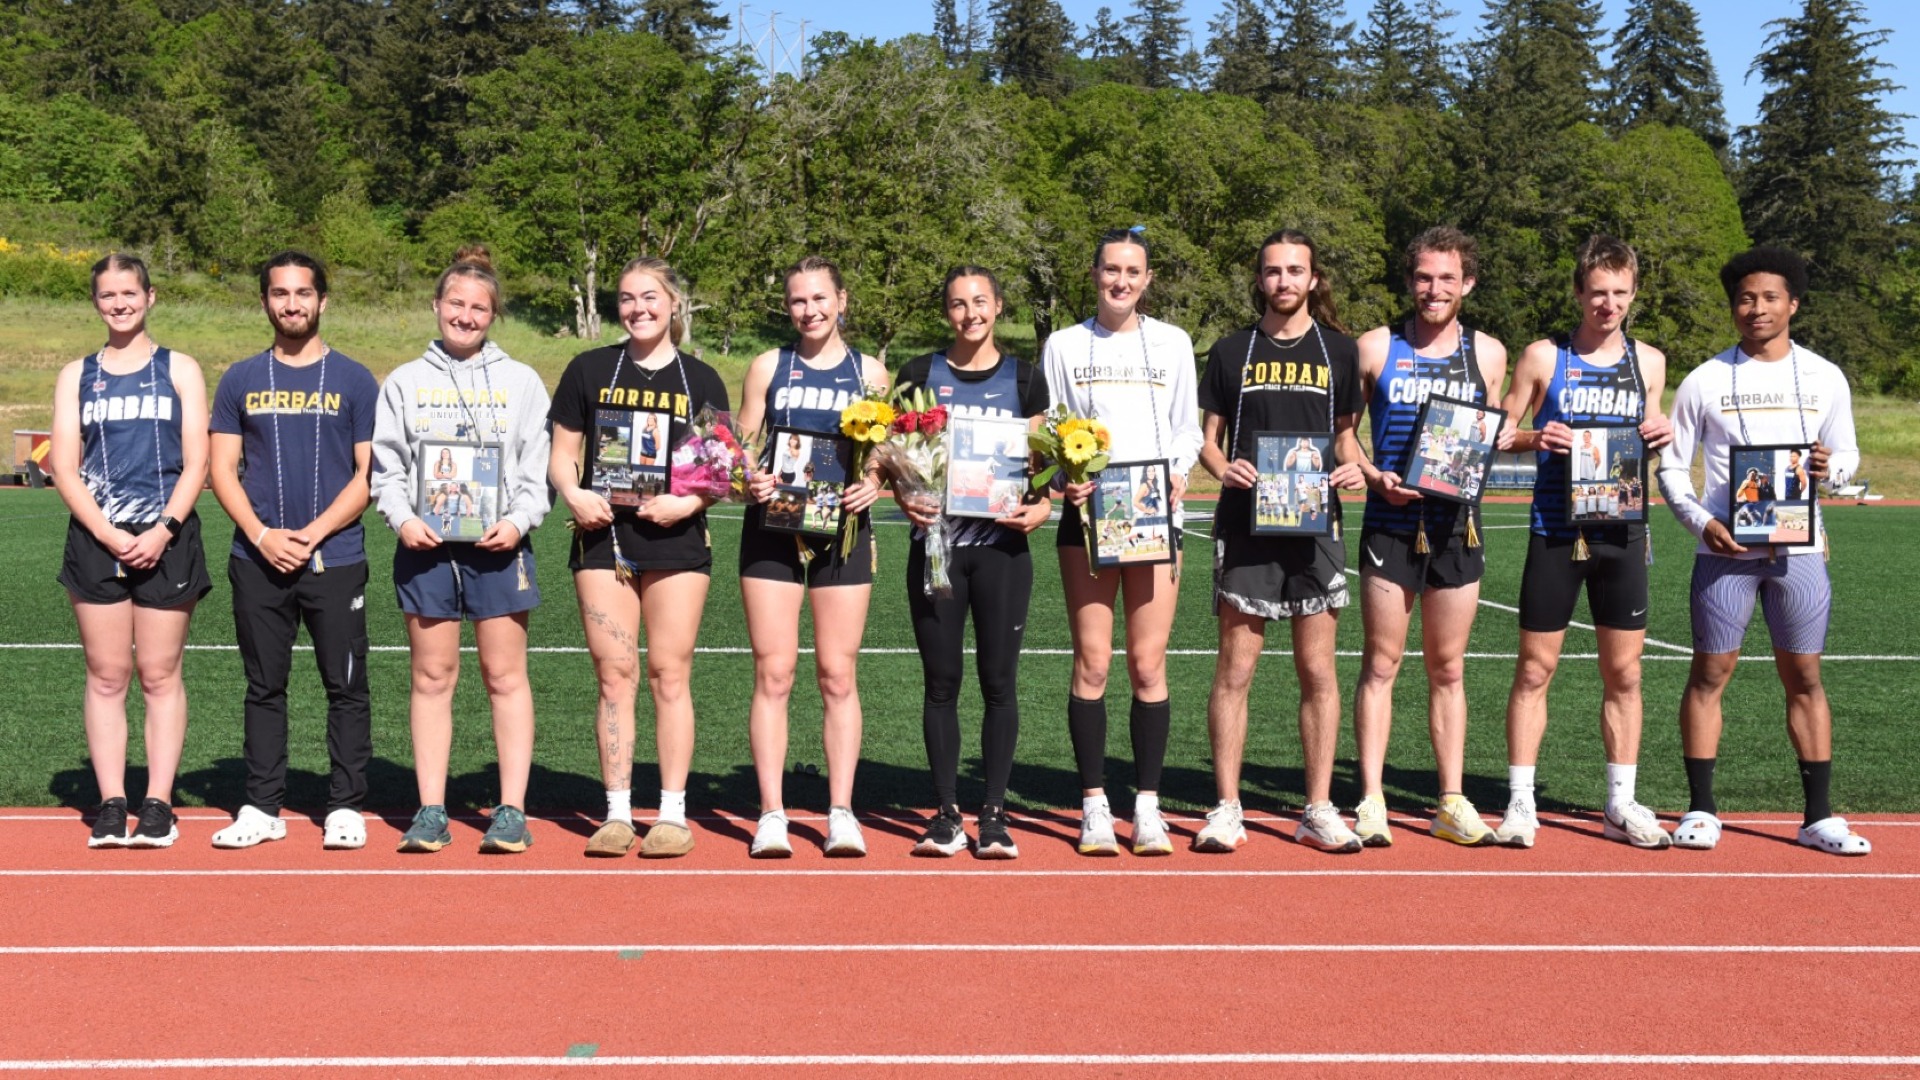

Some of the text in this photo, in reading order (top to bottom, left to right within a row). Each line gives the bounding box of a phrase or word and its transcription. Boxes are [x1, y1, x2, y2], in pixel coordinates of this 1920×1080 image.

[1074, 366, 1134, 379] CORBAN
[1242, 361, 1329, 388] CORBAN
[245, 390, 341, 410] CORBAN
[416, 387, 508, 409] CORBAN
[774, 386, 850, 412] CORBA
[1388, 377, 1477, 403] CORBAN
[1558, 387, 1640, 418] CORBAN
[1720, 393, 1785, 407] CORBAN
[82, 395, 173, 426] CORBAN
